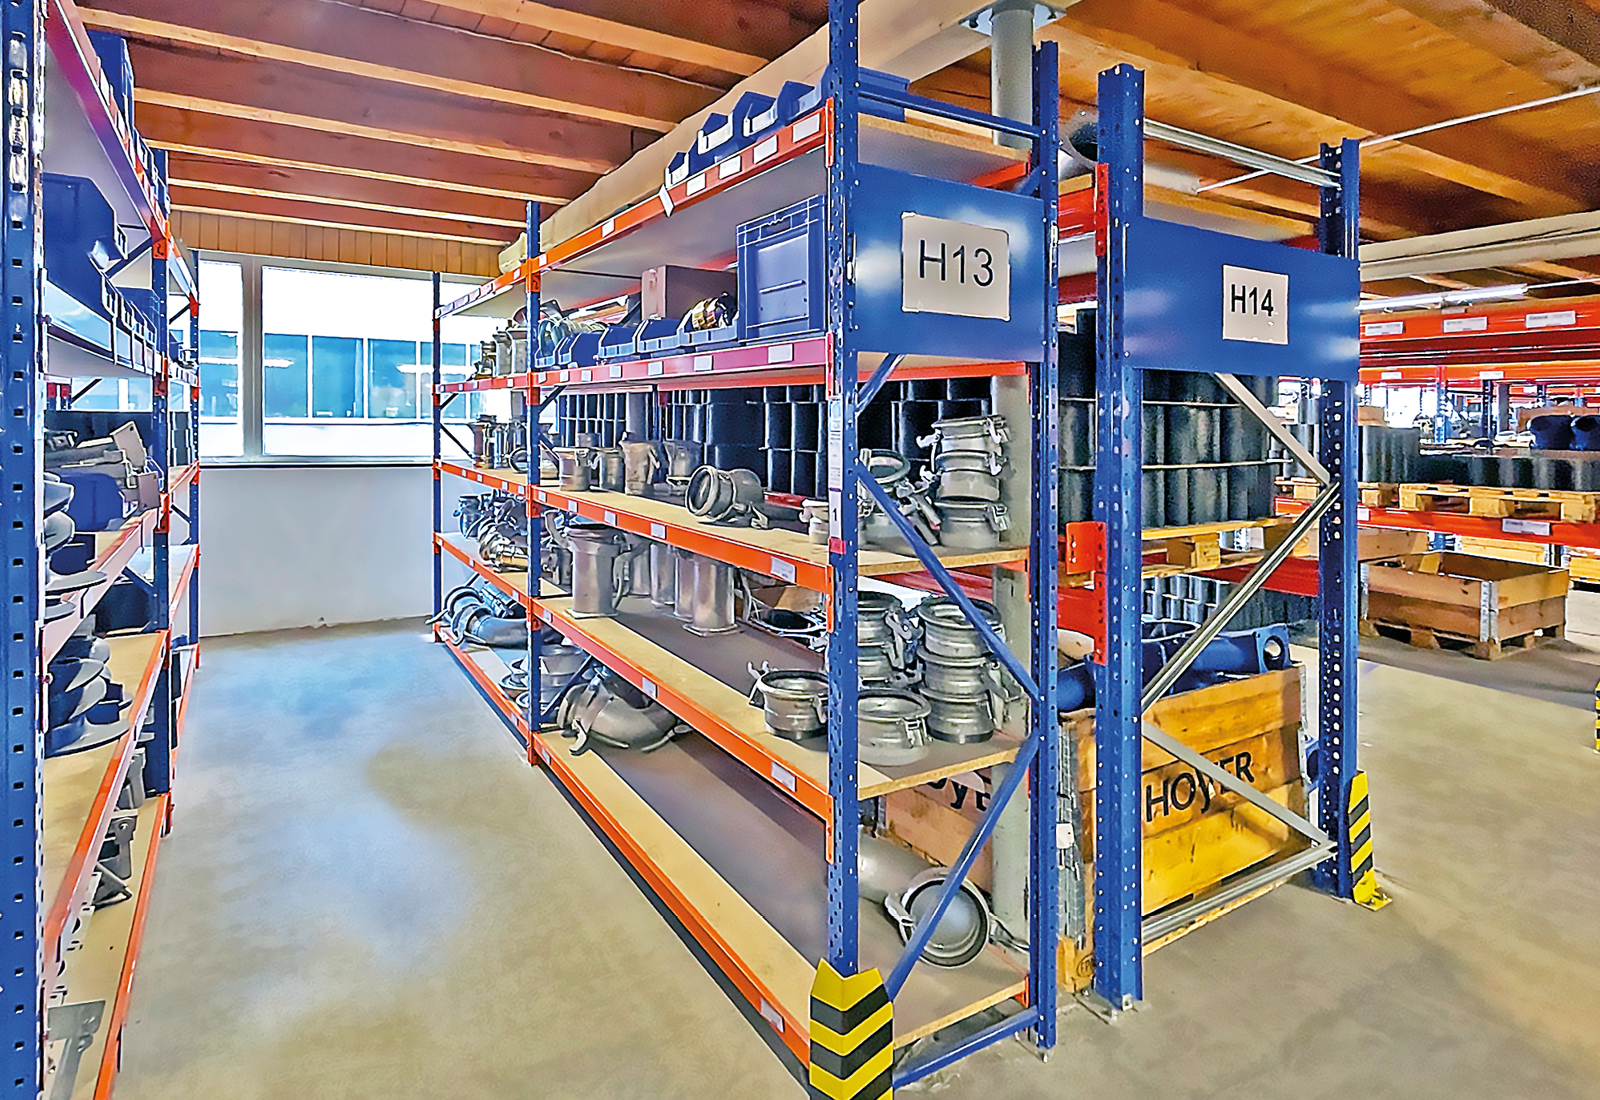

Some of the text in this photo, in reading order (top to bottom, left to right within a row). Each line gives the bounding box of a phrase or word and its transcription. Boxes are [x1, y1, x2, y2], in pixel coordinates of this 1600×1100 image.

[919, 239, 994, 287] H13
[1231, 283, 1274, 317] H14
[832, 507, 838, 522] 1
